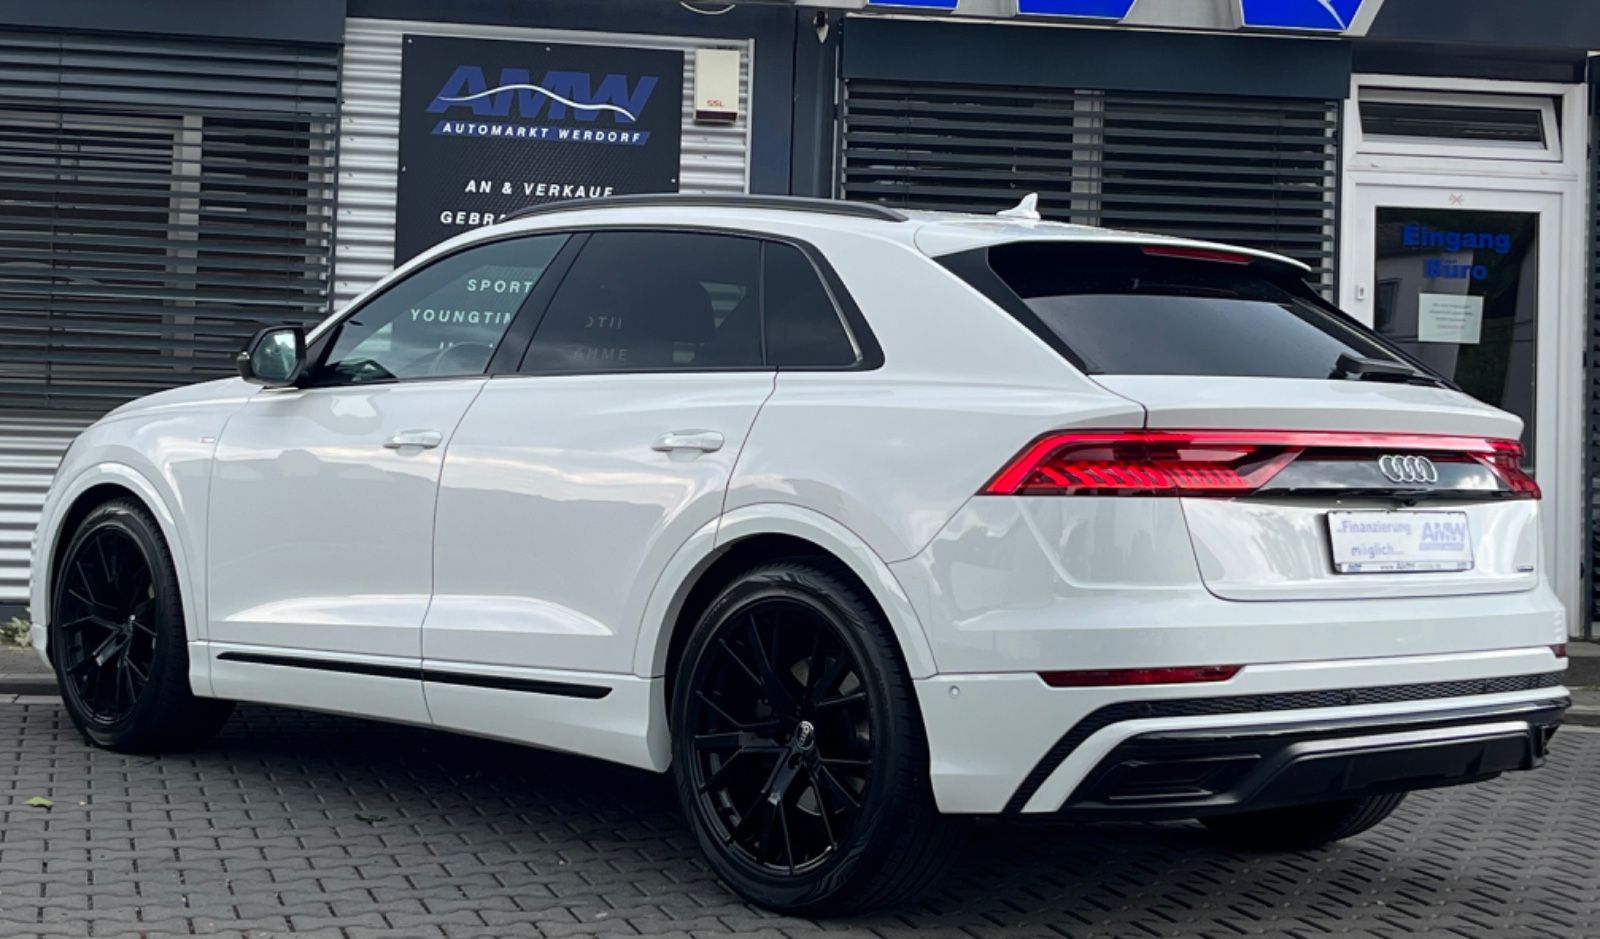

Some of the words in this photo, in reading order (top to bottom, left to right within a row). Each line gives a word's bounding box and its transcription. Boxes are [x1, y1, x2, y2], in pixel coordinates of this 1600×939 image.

[426, 65, 659, 123] AMW
[442, 122, 549, 138] AUTOMARKT
[558, 129, 641, 143] WERDORF
[465, 180, 492, 193] AN
[502, 182, 513, 195] &
[523, 182, 614, 198] VERKAUF
[440, 210, 507, 225] GEBR
[1403, 224, 1512, 254] Eingang
[1424, 258, 1488, 280] Büro
